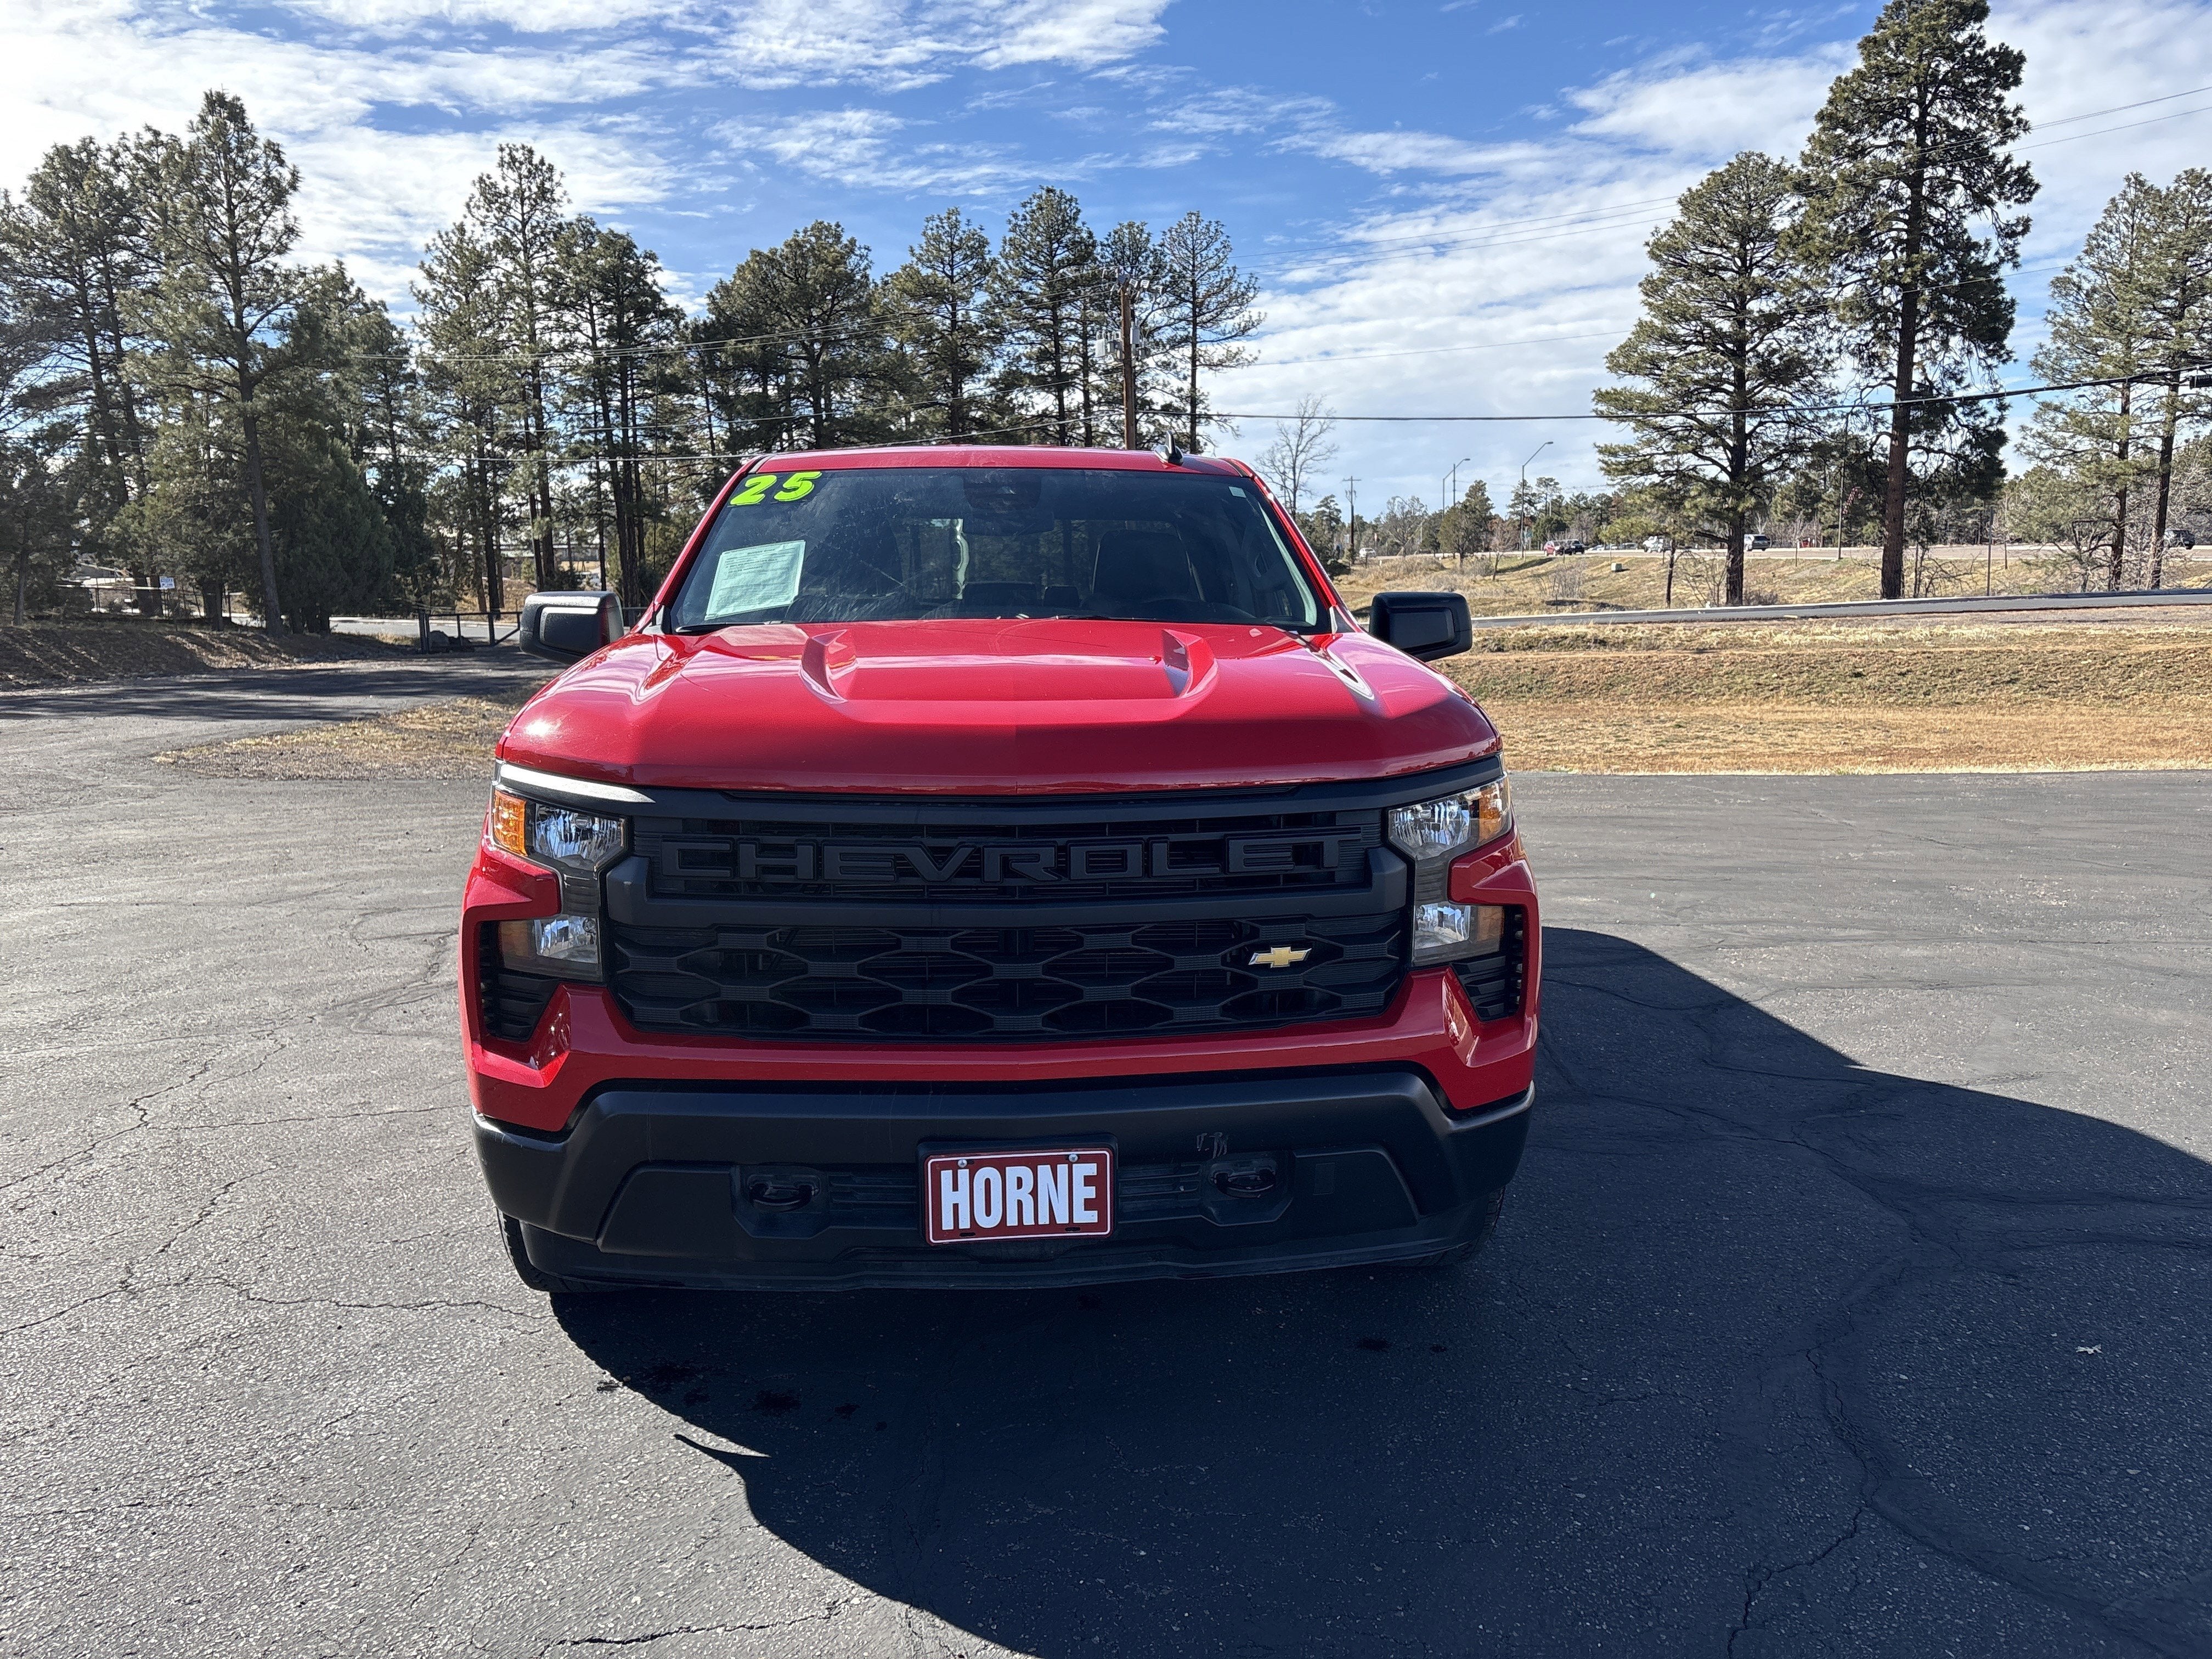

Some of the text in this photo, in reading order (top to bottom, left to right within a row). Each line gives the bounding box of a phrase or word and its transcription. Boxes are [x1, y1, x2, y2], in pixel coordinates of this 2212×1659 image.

[730, 471, 822, 505] 25
[661, 831, 1362, 883] CHEVROLET
[940, 1163, 1098, 1231] HORNE
